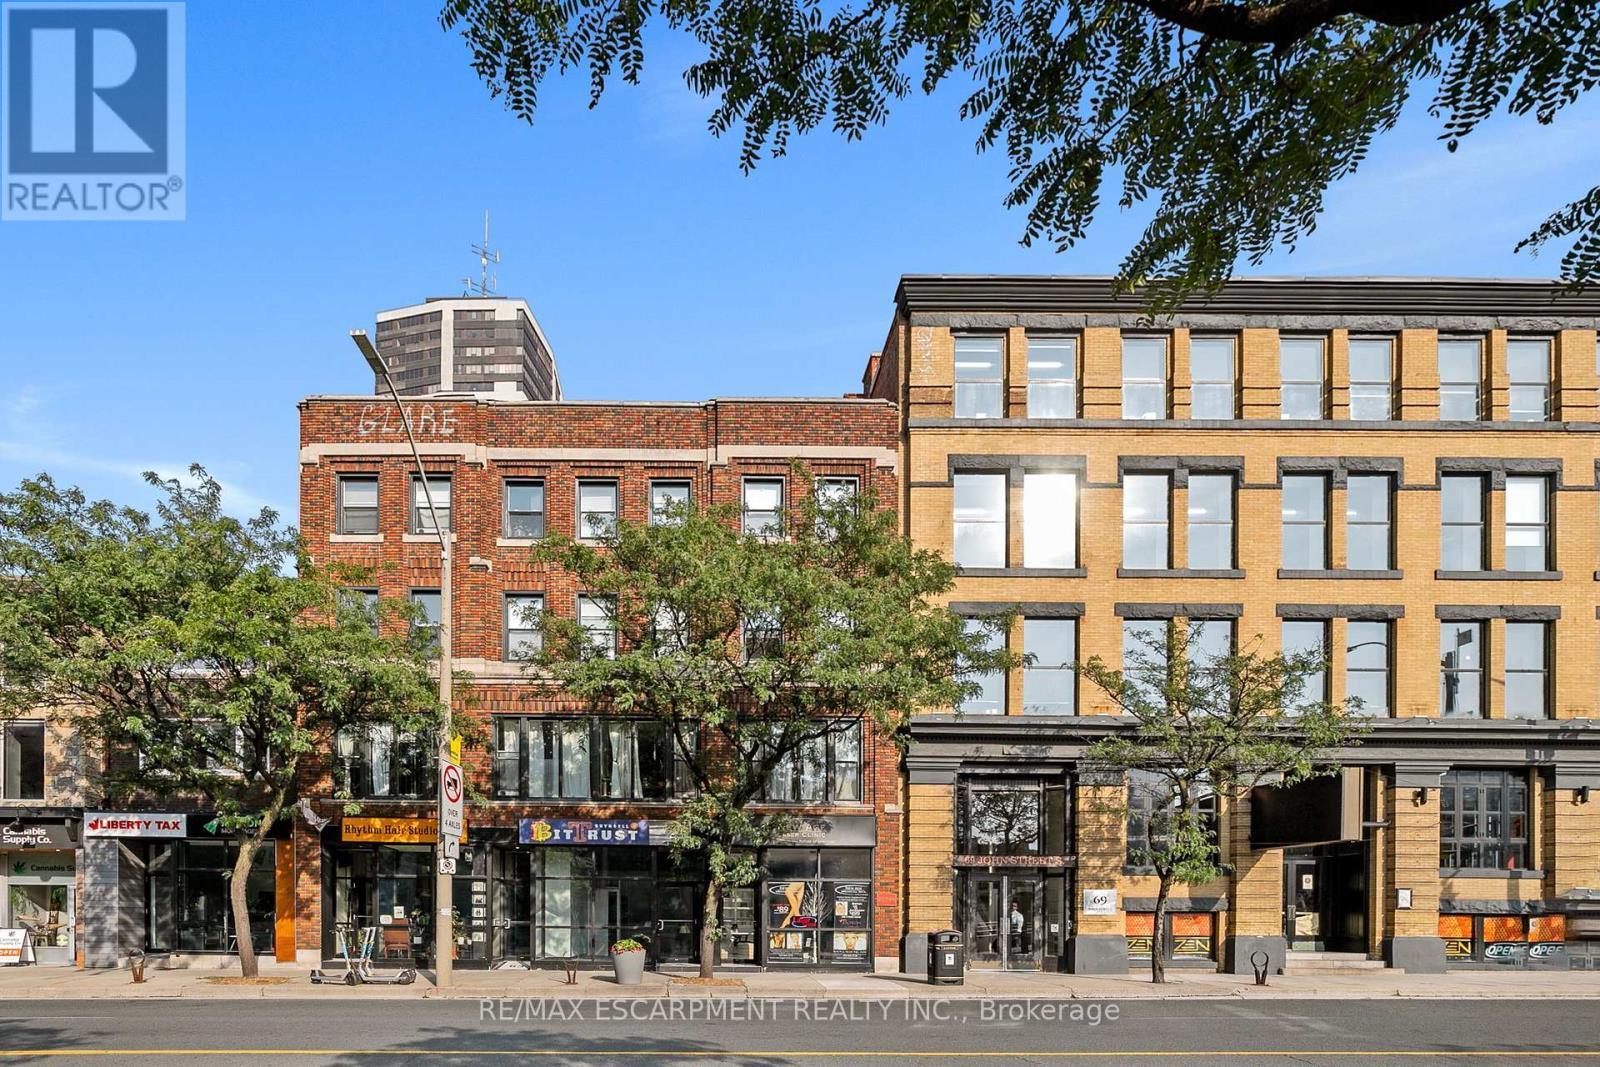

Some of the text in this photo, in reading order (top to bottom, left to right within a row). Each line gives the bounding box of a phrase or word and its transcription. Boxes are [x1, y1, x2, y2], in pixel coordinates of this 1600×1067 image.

[357, 404, 459, 435] GLARE
[448, 808, 459, 818] OVER
[100, 820, 181, 830] LIBERTY TAX
[344, 824, 438, 836] Rhythm Hair Studio
[3, 835, 52, 845] Supply Co.
[964, 855, 976, 865] 69
[978, 855, 1009, 865] JOHN
[1010, 855, 1055, 865] STREET
[30, 864, 65, 872] Cannabis
[1093, 895, 1108, 906] 69
[1174, 939, 1210, 952] ZEN
